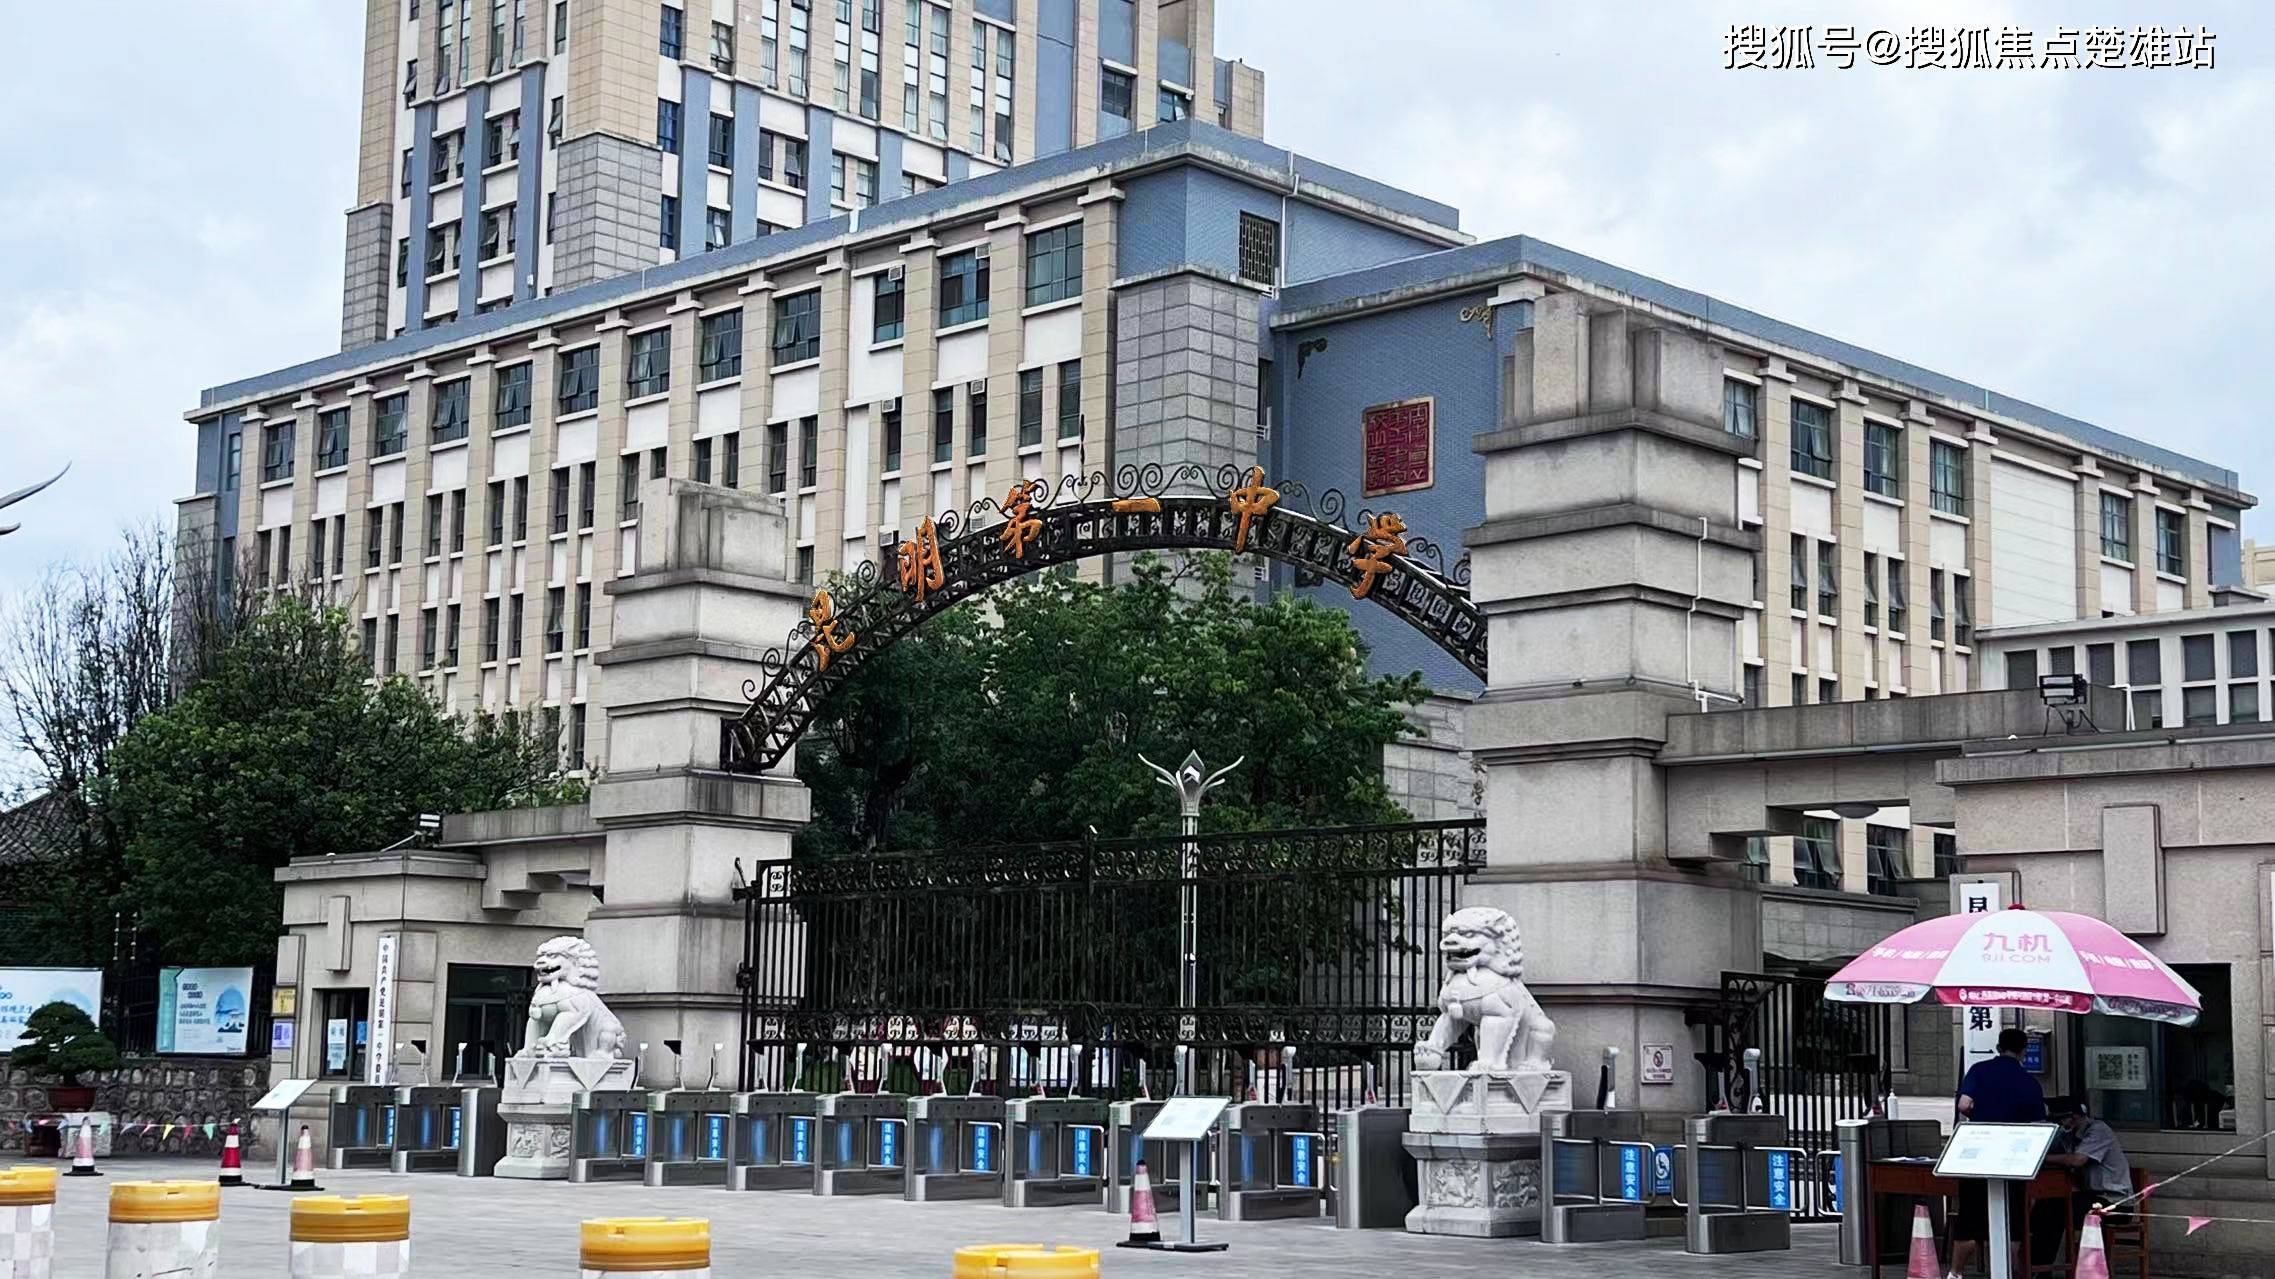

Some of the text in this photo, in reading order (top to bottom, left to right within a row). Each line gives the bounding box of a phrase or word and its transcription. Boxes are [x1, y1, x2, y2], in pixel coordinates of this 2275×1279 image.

[809, 465, 1408, 671] 昆明第一中学
[1983, 932, 2053, 952] 九机
